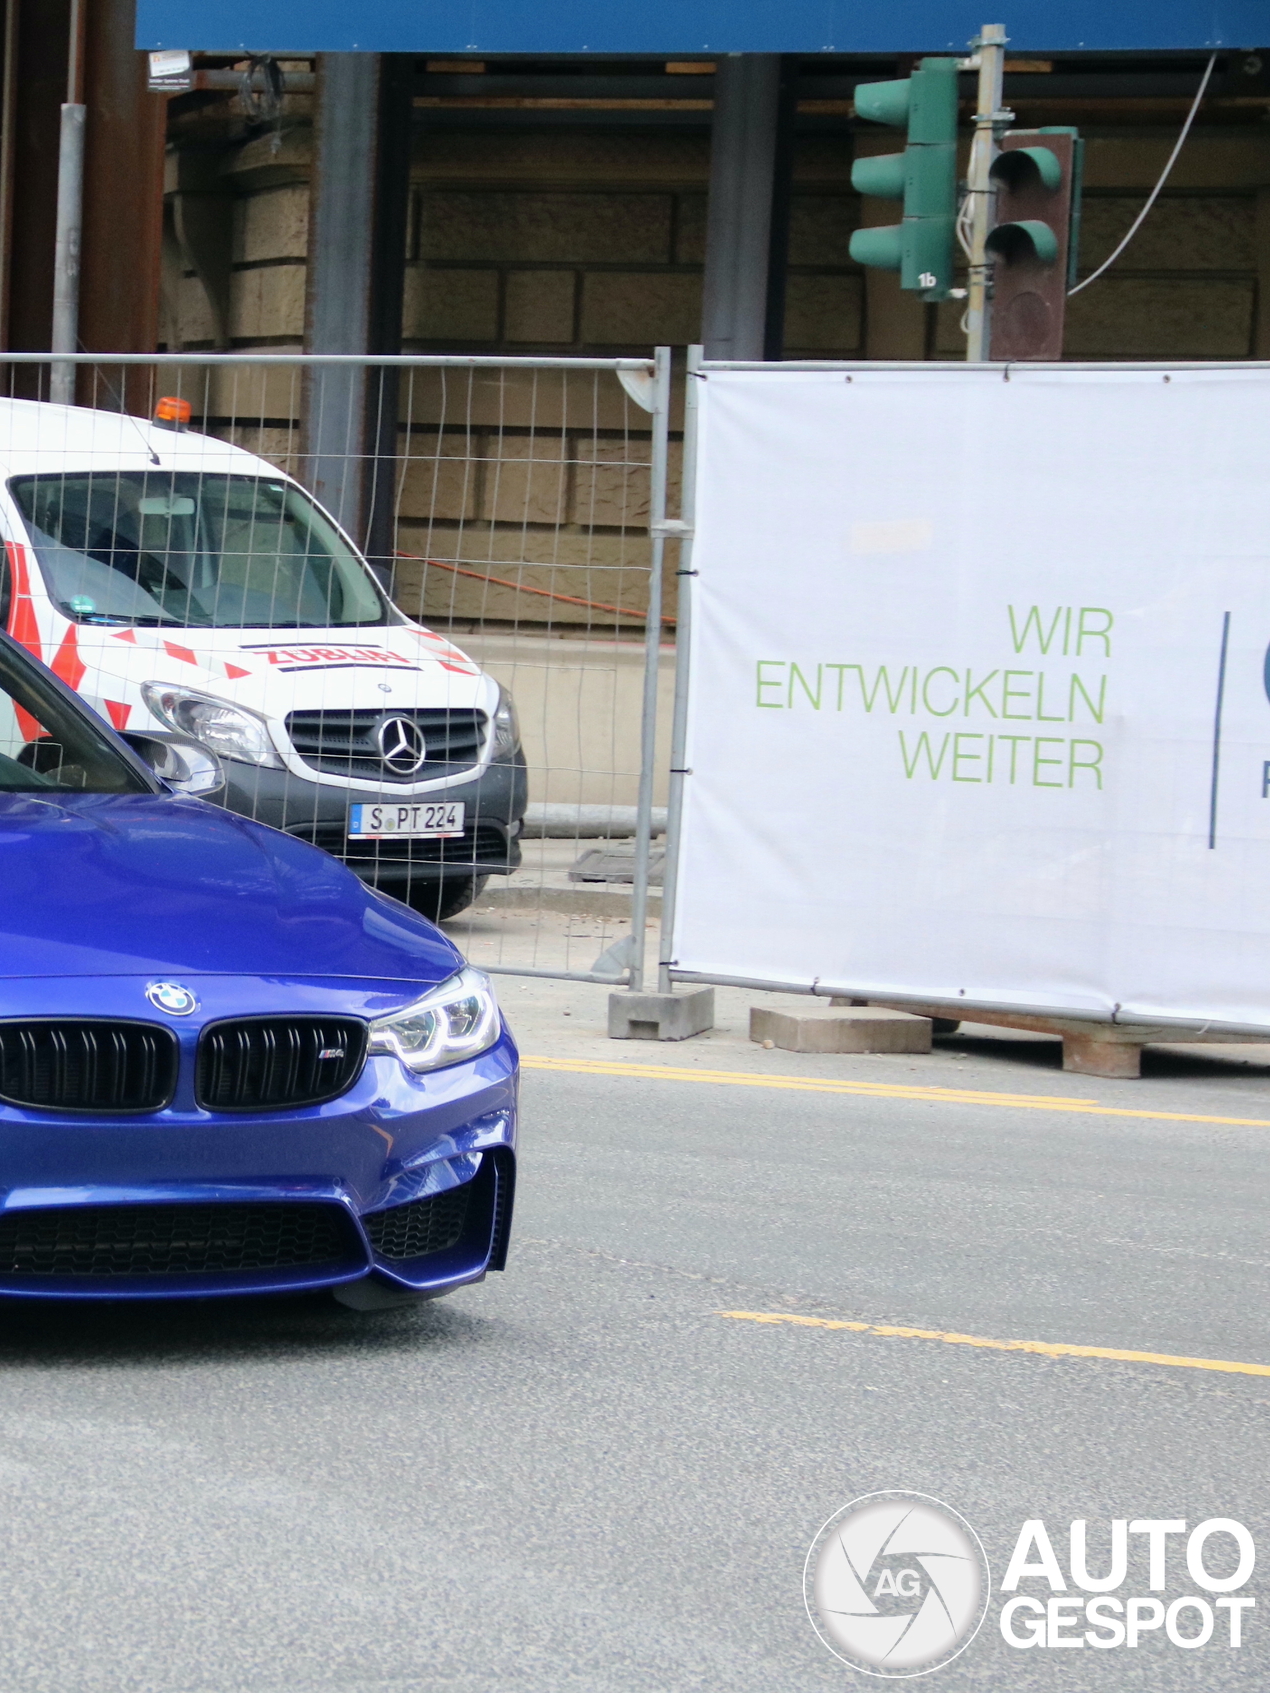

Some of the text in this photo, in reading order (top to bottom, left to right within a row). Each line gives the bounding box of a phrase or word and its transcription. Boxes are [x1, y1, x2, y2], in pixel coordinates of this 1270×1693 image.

[918, 271, 937, 287] 1b
[1008, 604, 1114, 658] WIR
[253, 648, 412, 665] ZÜBLIN
[756, 660, 1107, 724] ENTWICKELN
[898, 730, 1104, 791] WEITER
[370, 805, 456, 830] S PT 224
